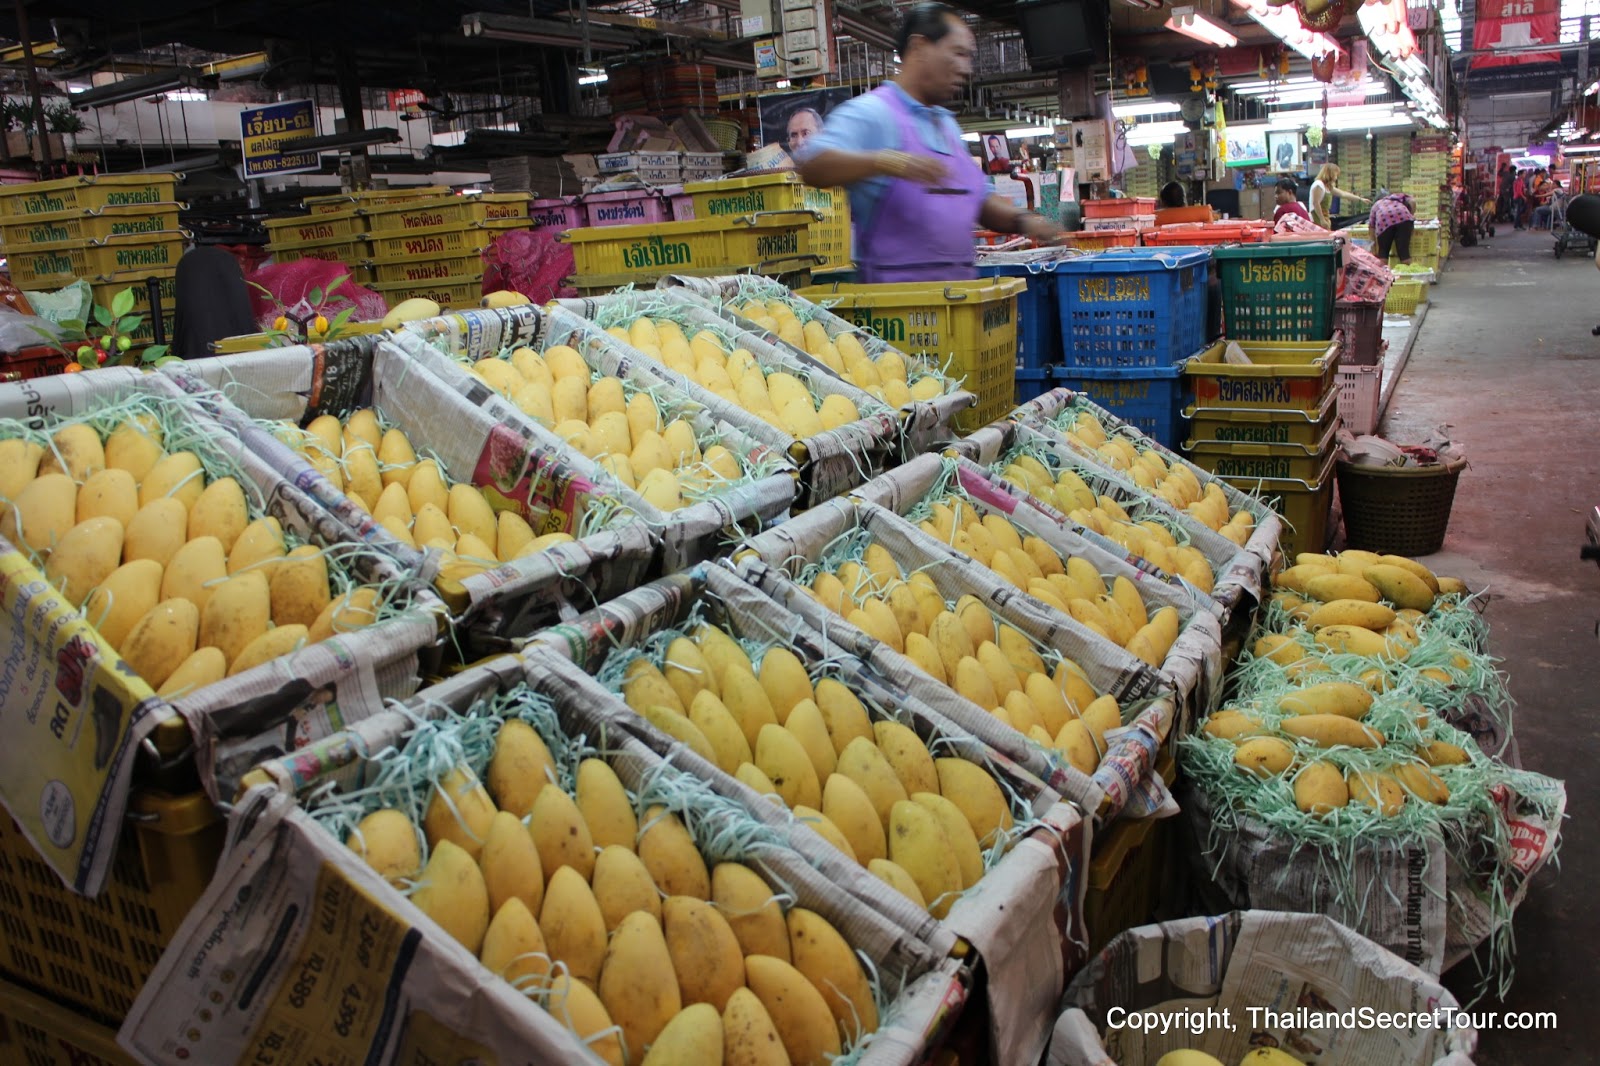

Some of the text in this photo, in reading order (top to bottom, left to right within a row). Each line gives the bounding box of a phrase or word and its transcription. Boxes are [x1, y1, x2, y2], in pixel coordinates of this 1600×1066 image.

[107, 187, 160, 204] จตพรผลไม้
[112, 217, 164, 235] จตพรผลไม้
[1215, 424, 1289, 442] จตพรผลไม้
[1217, 458, 1290, 478] จตพรผลไม้
